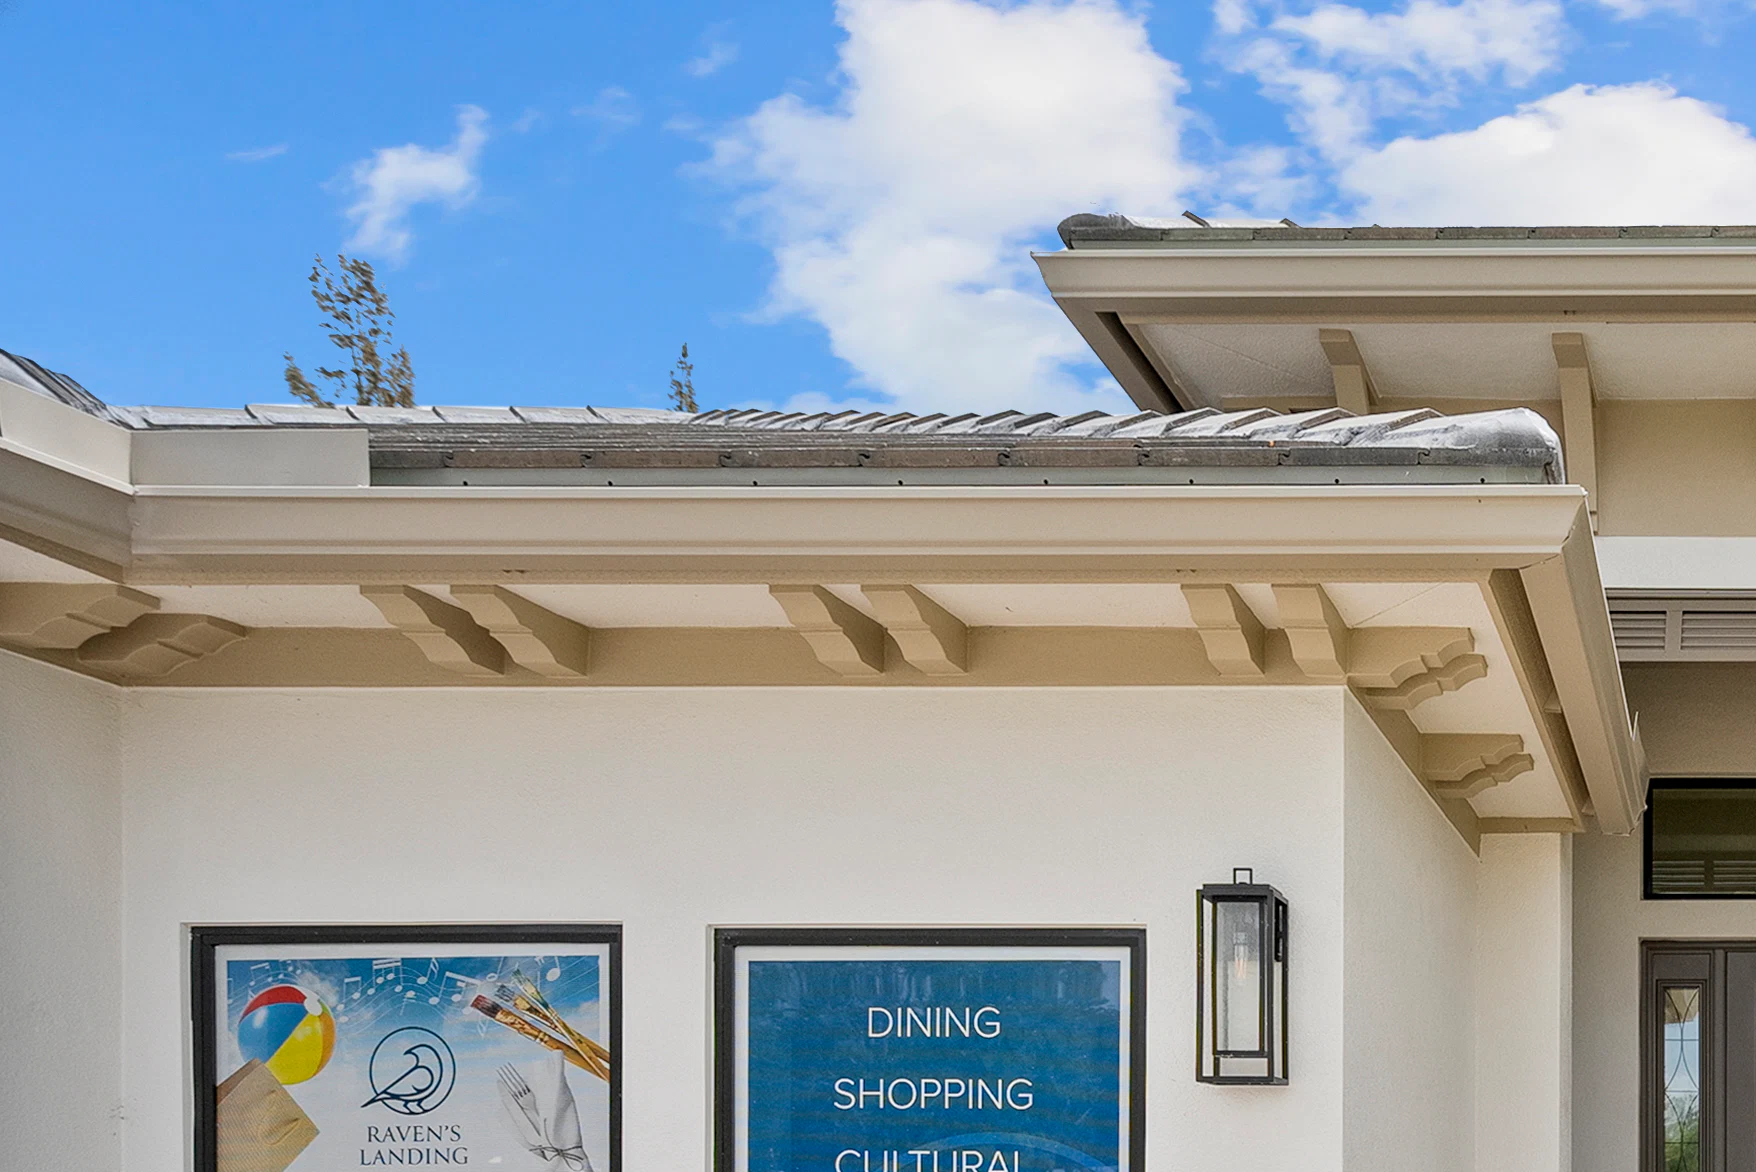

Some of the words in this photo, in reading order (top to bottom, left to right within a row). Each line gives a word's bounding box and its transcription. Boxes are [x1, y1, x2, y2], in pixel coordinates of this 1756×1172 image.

[866, 1006, 1002, 1038] DINING
[833, 1076, 1034, 1110] SHOPPING
[367, 1124, 461, 1143] RAVEN'S
[360, 1147, 468, 1166] LANDING
